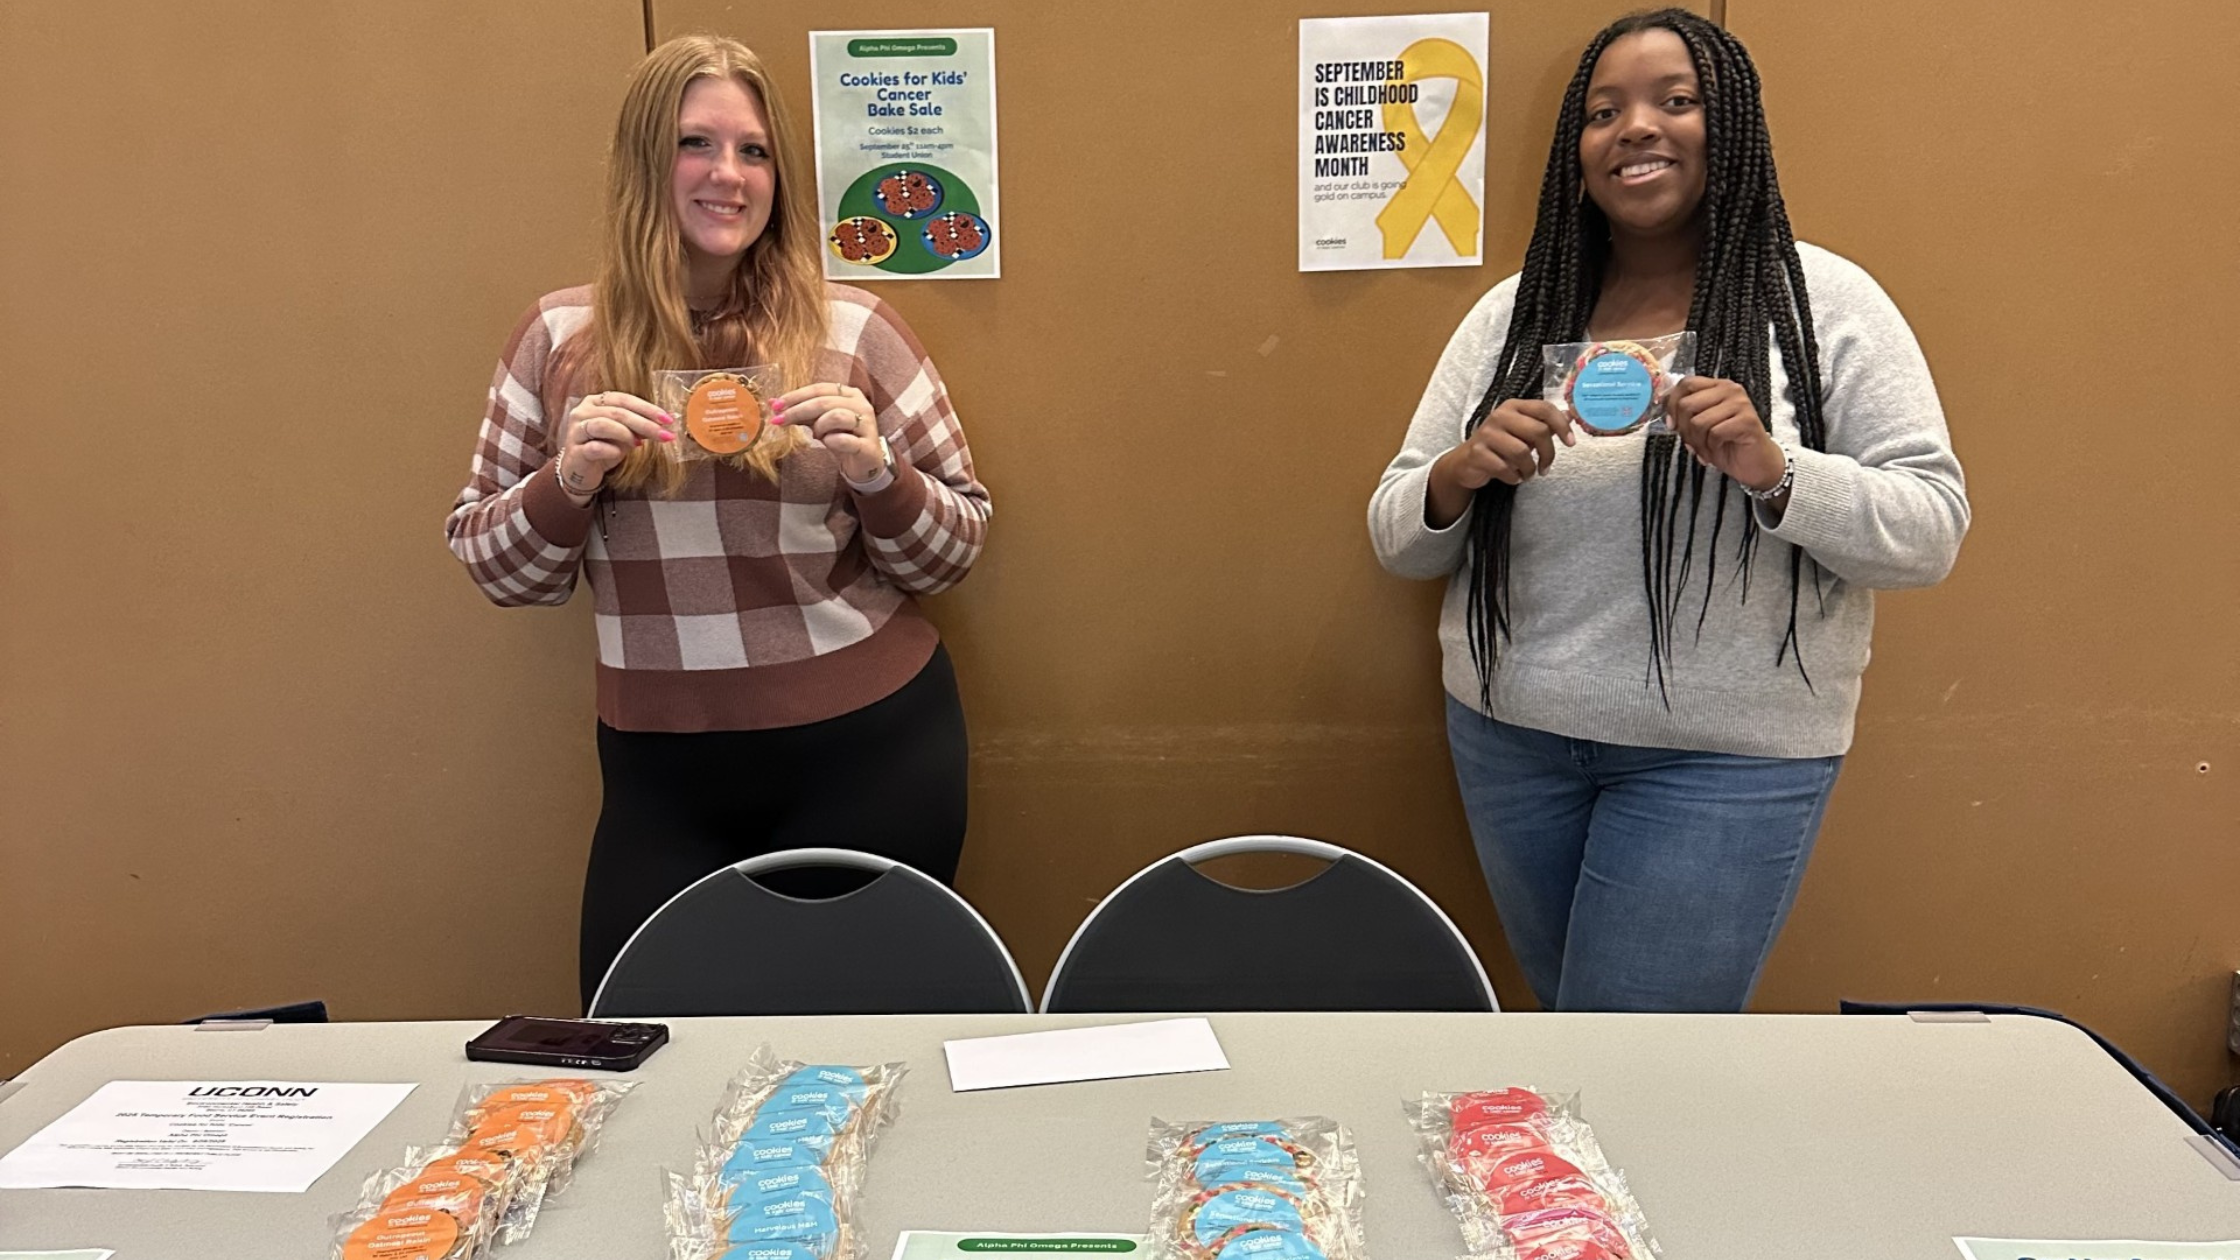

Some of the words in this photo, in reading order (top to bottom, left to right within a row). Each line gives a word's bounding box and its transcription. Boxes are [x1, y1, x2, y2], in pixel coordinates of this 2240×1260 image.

[859, 44, 879, 52] Alpha
[891, 44, 916, 52] Omega
[916, 43, 946, 51] Presents
[1315, 60, 1405, 83] SEPTEMBER
[840, 71, 900, 87] Cookies
[903, 72, 928, 85] for
[876, 87, 932, 101] Cancer
[1315, 87, 1330, 107] IS
[1334, 84, 1419, 106] CHILDHOOD
[867, 103, 905, 117] Bake
[908, 102, 943, 116] Sale
[1315, 109, 1374, 130] CANCER
[868, 126, 905, 135] Cookies
[907, 126, 919, 135] $2
[920, 126, 944, 135] each
[860, 143, 900, 151] September
[1315, 132, 1406, 154] AWARENESS
[1315, 156, 1369, 178] MONTH
[1314, 183, 1332, 191] and
[1333, 183, 1349, 191] our
[1350, 181, 1371, 190] club
[1371, 181, 1380, 190] is
[1380, 181, 1407, 191] going
[1314, 192, 1335, 203] gold
[1350, 192, 1387, 200] campus.
[1315, 238, 1347, 246] cookies
[1597, 359, 1628, 368] cookies
[818, 1070, 854, 1083] cookies
[188, 1086, 320, 1098] UCONN
[511, 1091, 549, 1099] cookies
[792, 1092, 828, 1100] cookies
[520, 1110, 555, 1118] cookies
[769, 1118, 808, 1129] cookies
[480, 1130, 518, 1144] cookies
[1481, 1131, 1521, 1141] cookies
[1218, 1141, 1257, 1149] cookies
[753, 1146, 793, 1157] cookies
[1504, 1158, 1544, 1173] cookies
[758, 1174, 800, 1187] cookies
[1244, 1170, 1284, 1181] cookies
[419, 1181, 460, 1191] cookies
[1235, 1194, 1276, 1206] cookies
[763, 1200, 806, 1212] cookies
[388, 1214, 432, 1226] cookies
[755, 1224, 797, 1234] Marvelous
[368, 1240, 404, 1248] Oatmeal
[1239, 1234, 1283, 1248] cookies
[748, 1248, 793, 1256] cookies
